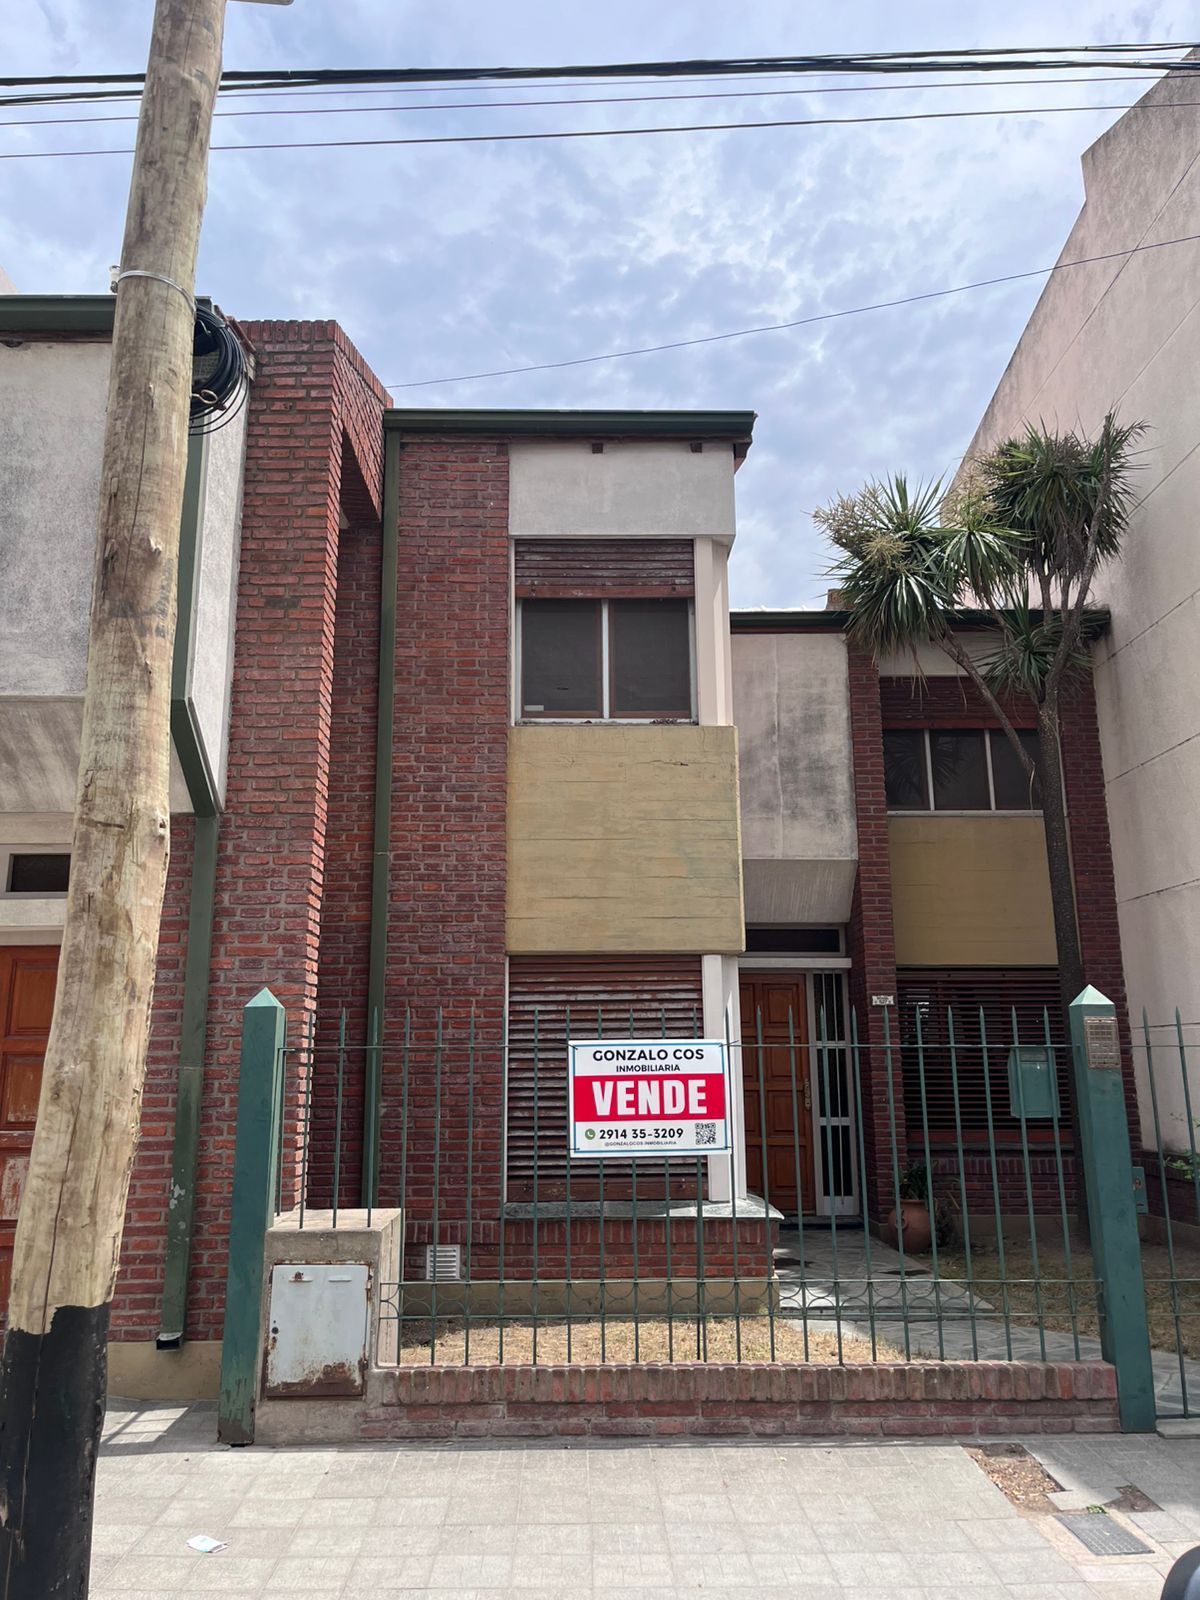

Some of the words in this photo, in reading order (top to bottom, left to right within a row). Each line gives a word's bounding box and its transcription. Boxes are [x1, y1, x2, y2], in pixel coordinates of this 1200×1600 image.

[592, 1049, 669, 1062] GONZALO
[673, 1049, 704, 1060] COS
[616, 1064, 680, 1073] INMOBILIARIA
[591, 1079, 708, 1116] VENDE
[599, 1129, 628, 1139] 2914
[632, 1128, 684, 1138] 35-3209
